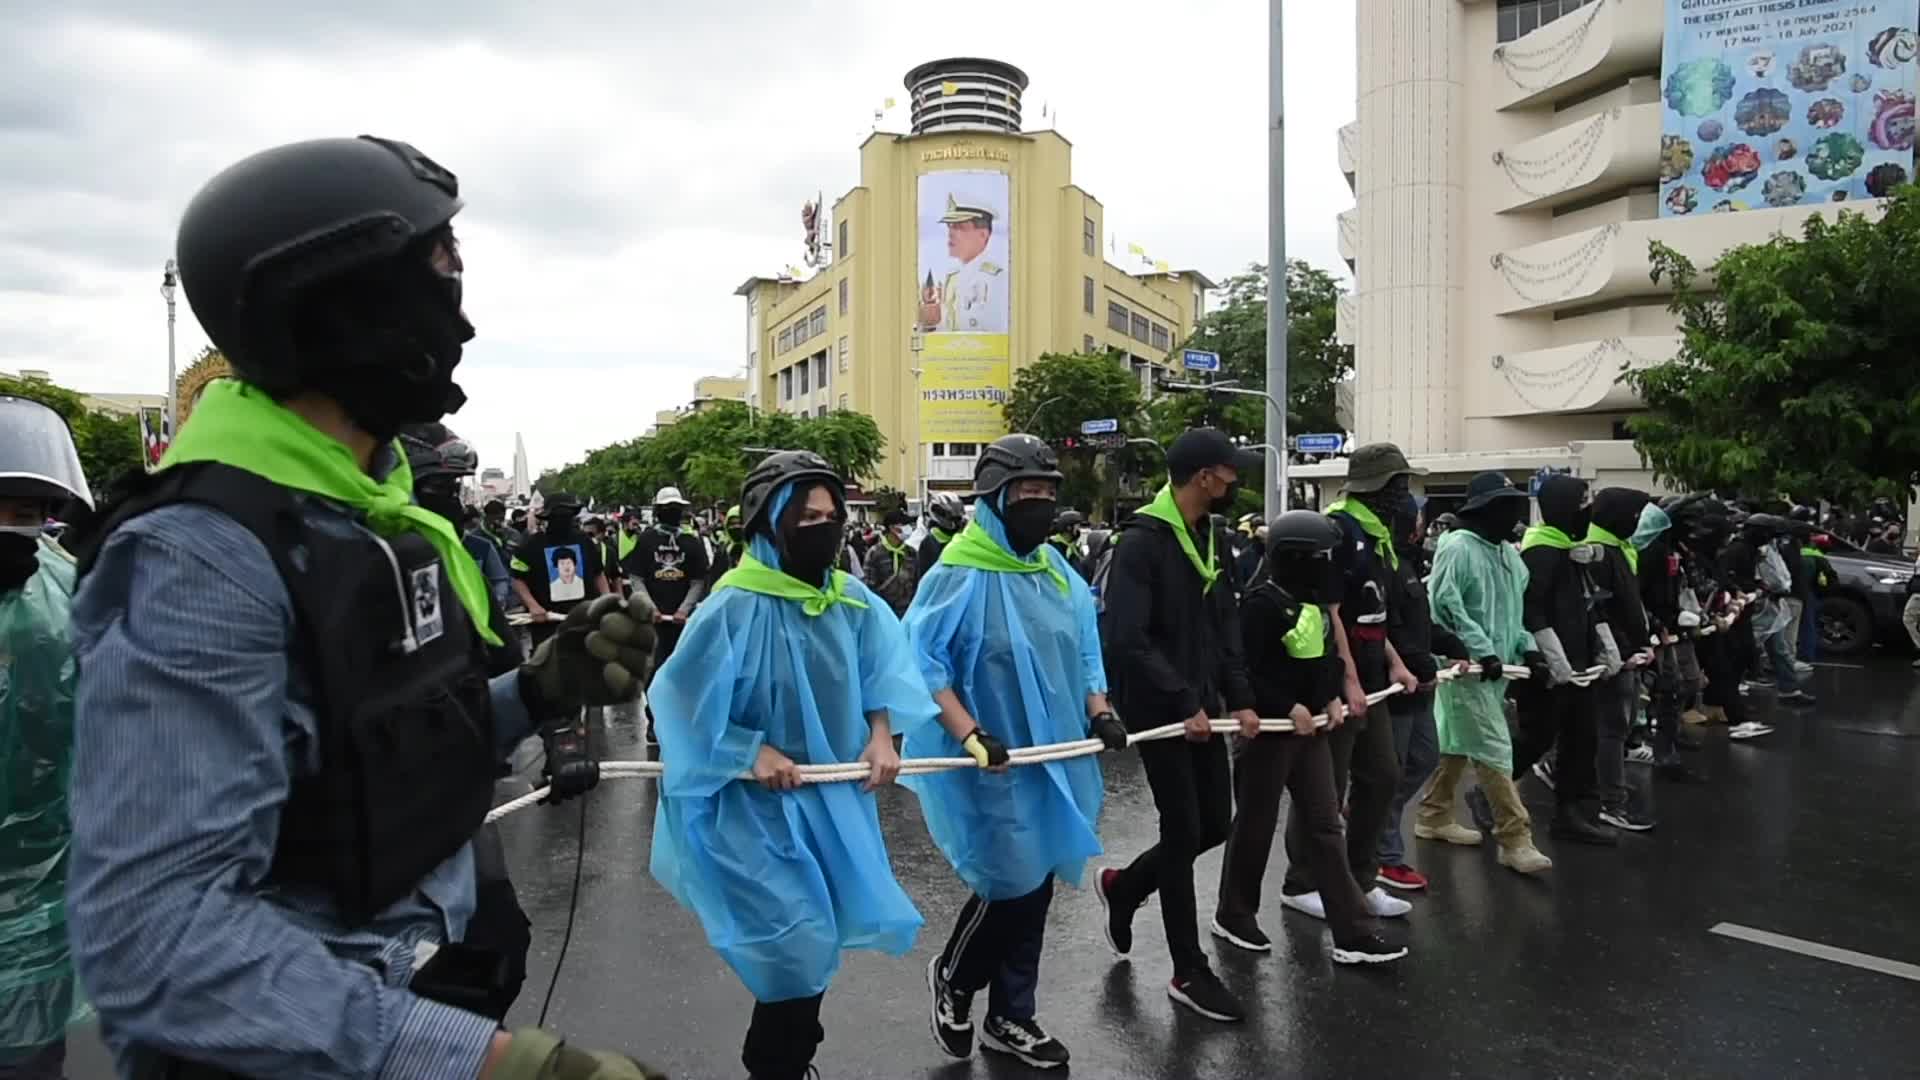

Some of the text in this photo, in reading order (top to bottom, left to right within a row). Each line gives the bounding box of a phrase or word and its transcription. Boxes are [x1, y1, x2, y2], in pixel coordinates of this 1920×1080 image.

[1683, 15, 1701, 25] THE
[1704, 11, 1730, 22] BEST
[1733, 7, 1754, 17] ART
[1759, 1, 1796, 14] THESIS
[1823, 20, 1854, 33] 2021
